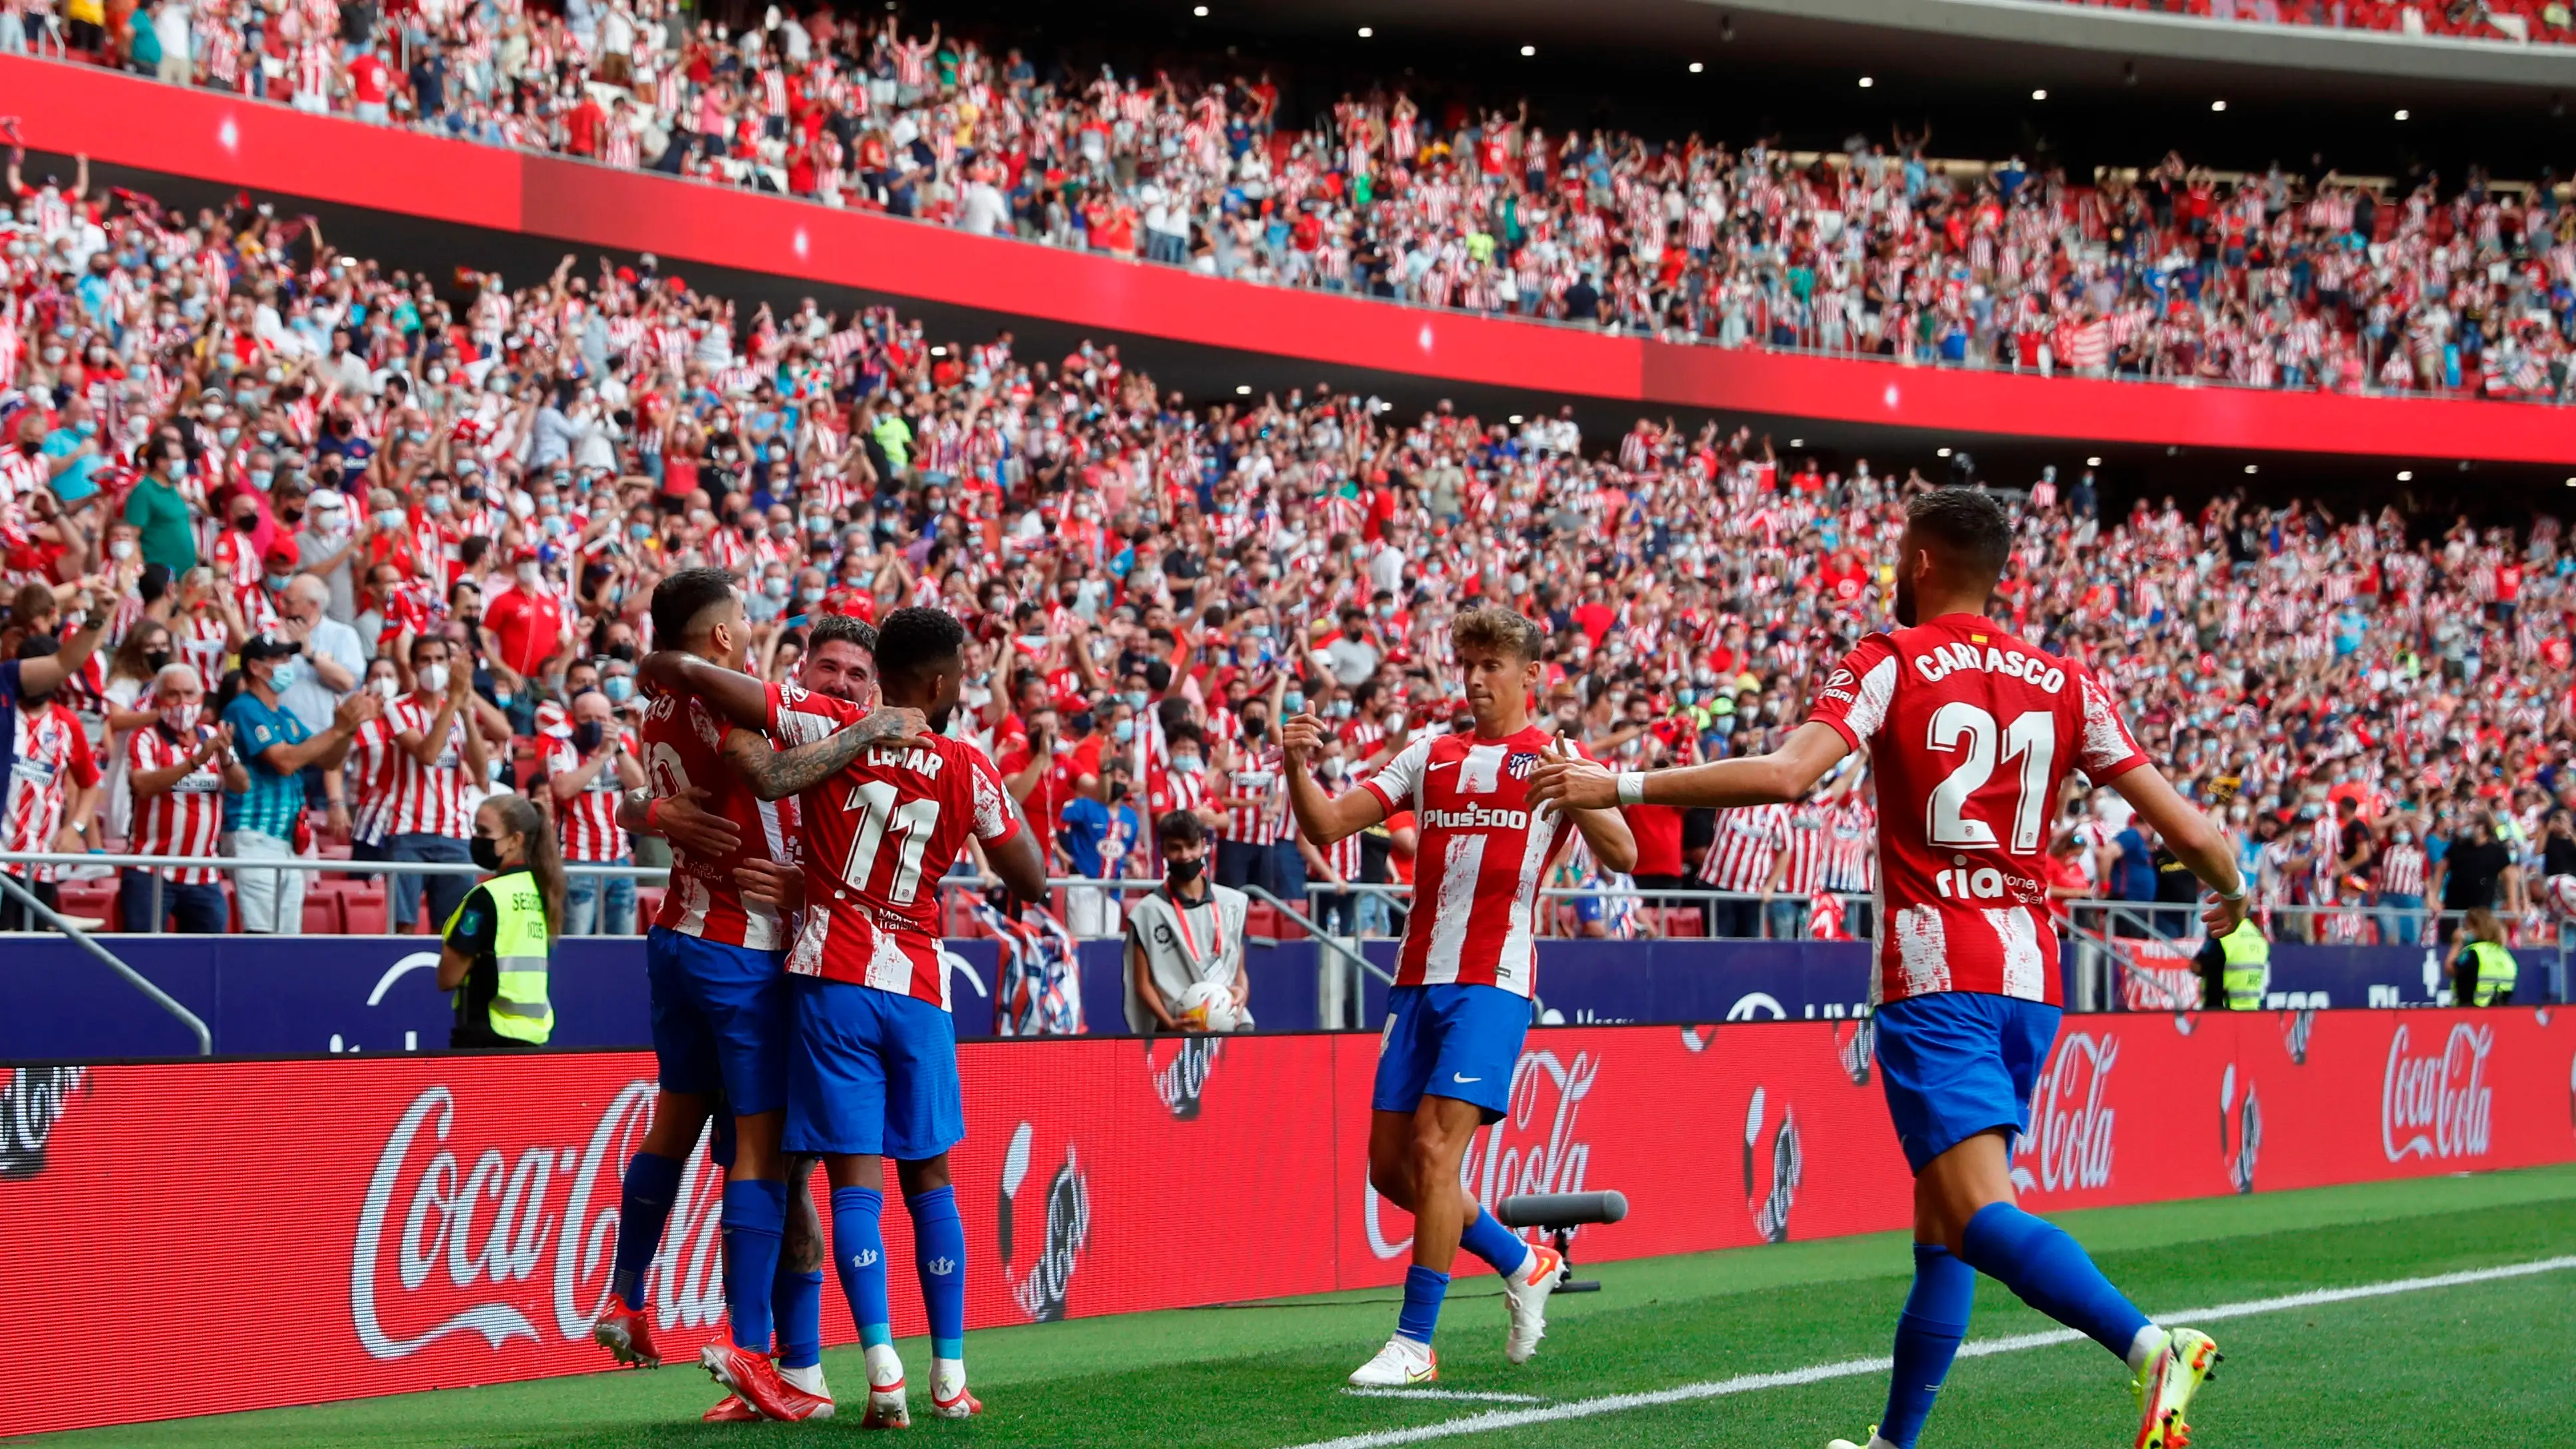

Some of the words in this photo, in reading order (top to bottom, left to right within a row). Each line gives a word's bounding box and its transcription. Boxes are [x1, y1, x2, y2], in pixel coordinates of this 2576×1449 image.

[867, 744, 943, 780] LEMAR
[1423, 808, 1528, 830] Plus500
[1927, 701, 2054, 855] 21
[842, 779, 940, 907] 11
[1935, 854, 2005, 899] ria
[2002, 873, 2039, 893] oney
[2010, 1032, 2120, 1196] a-Cola
[2382, 1022, 2496, 1163] Coca-Cola
[350, 1078, 727, 1360] Coca-Cla
